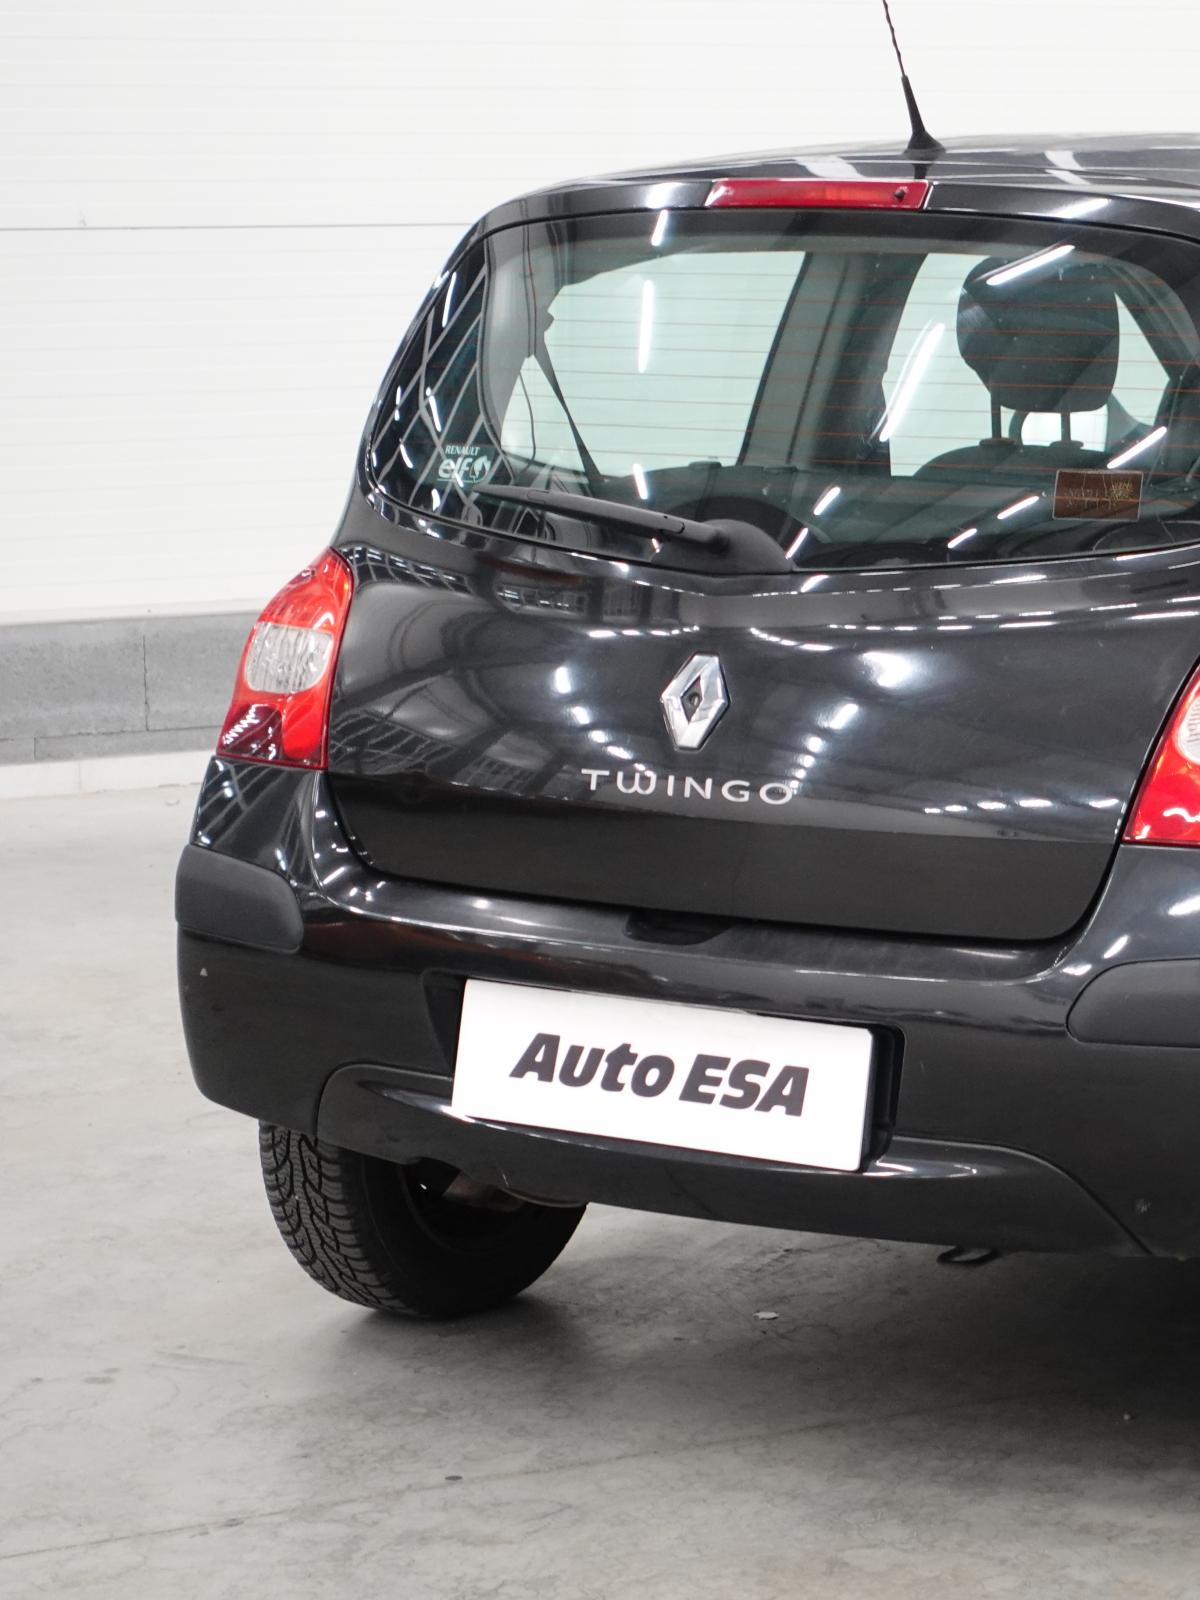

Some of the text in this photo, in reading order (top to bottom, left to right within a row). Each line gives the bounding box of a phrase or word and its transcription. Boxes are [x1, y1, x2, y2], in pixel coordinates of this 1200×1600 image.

[445, 445, 481, 456] RENAULT
[438, 457, 473, 479] elf
[581, 768, 793, 805] TWINGO
[510, 1034, 809, 1117] Auto ESA
